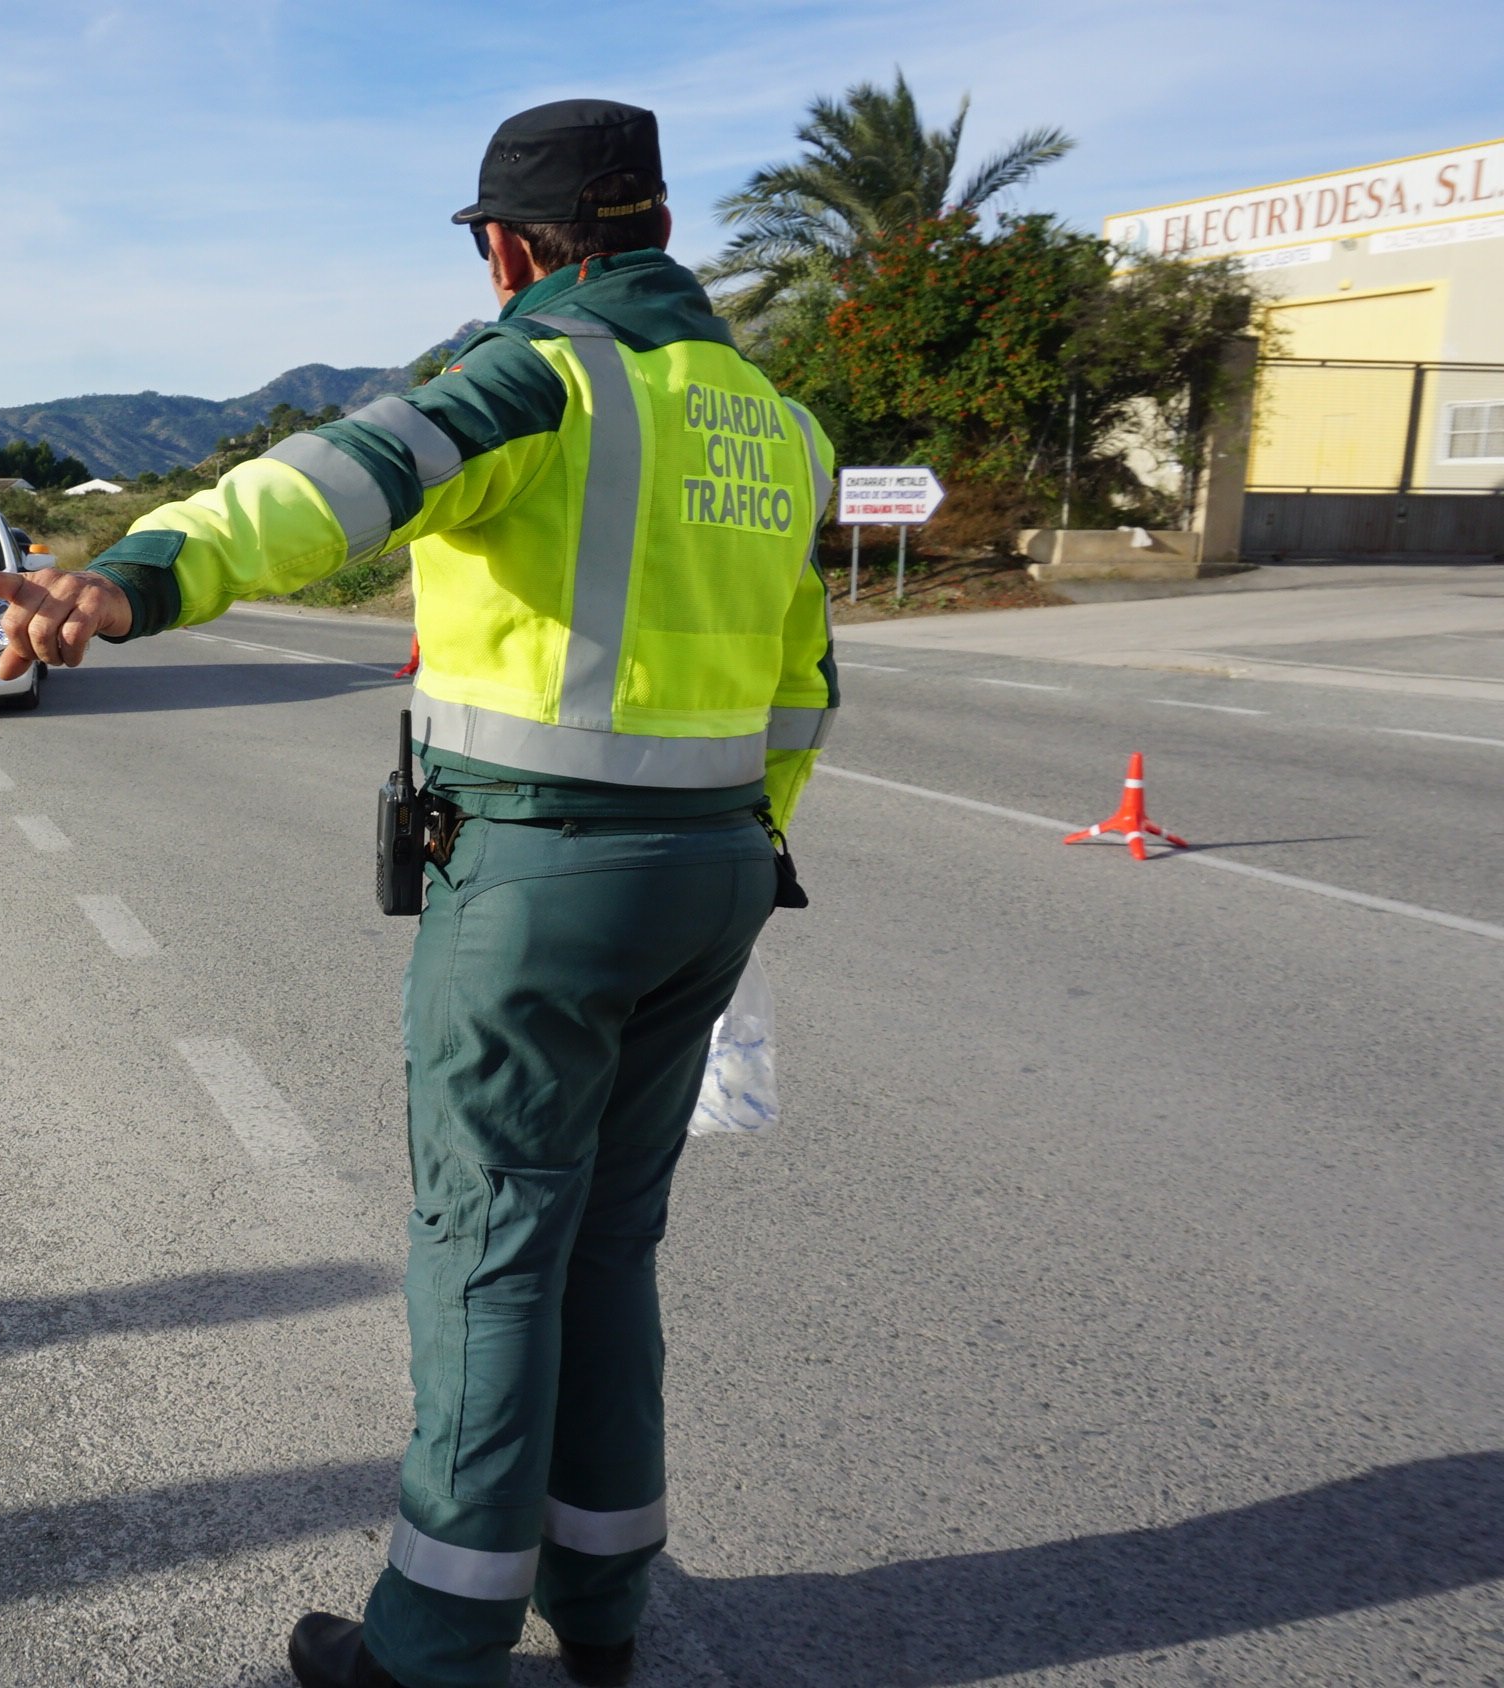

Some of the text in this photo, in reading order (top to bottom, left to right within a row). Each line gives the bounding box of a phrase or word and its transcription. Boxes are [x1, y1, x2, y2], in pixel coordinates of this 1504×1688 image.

[597, 198, 652, 217] GUARDIA CIVIL
[1162, 157, 1504, 256] ELECTRYDESA, S.L.
[686, 383, 786, 441] GUARDIA
[707, 433, 770, 484] CIVIL
[895, 476, 929, 487] METALES
[684, 478, 793, 533] TRAFICO
